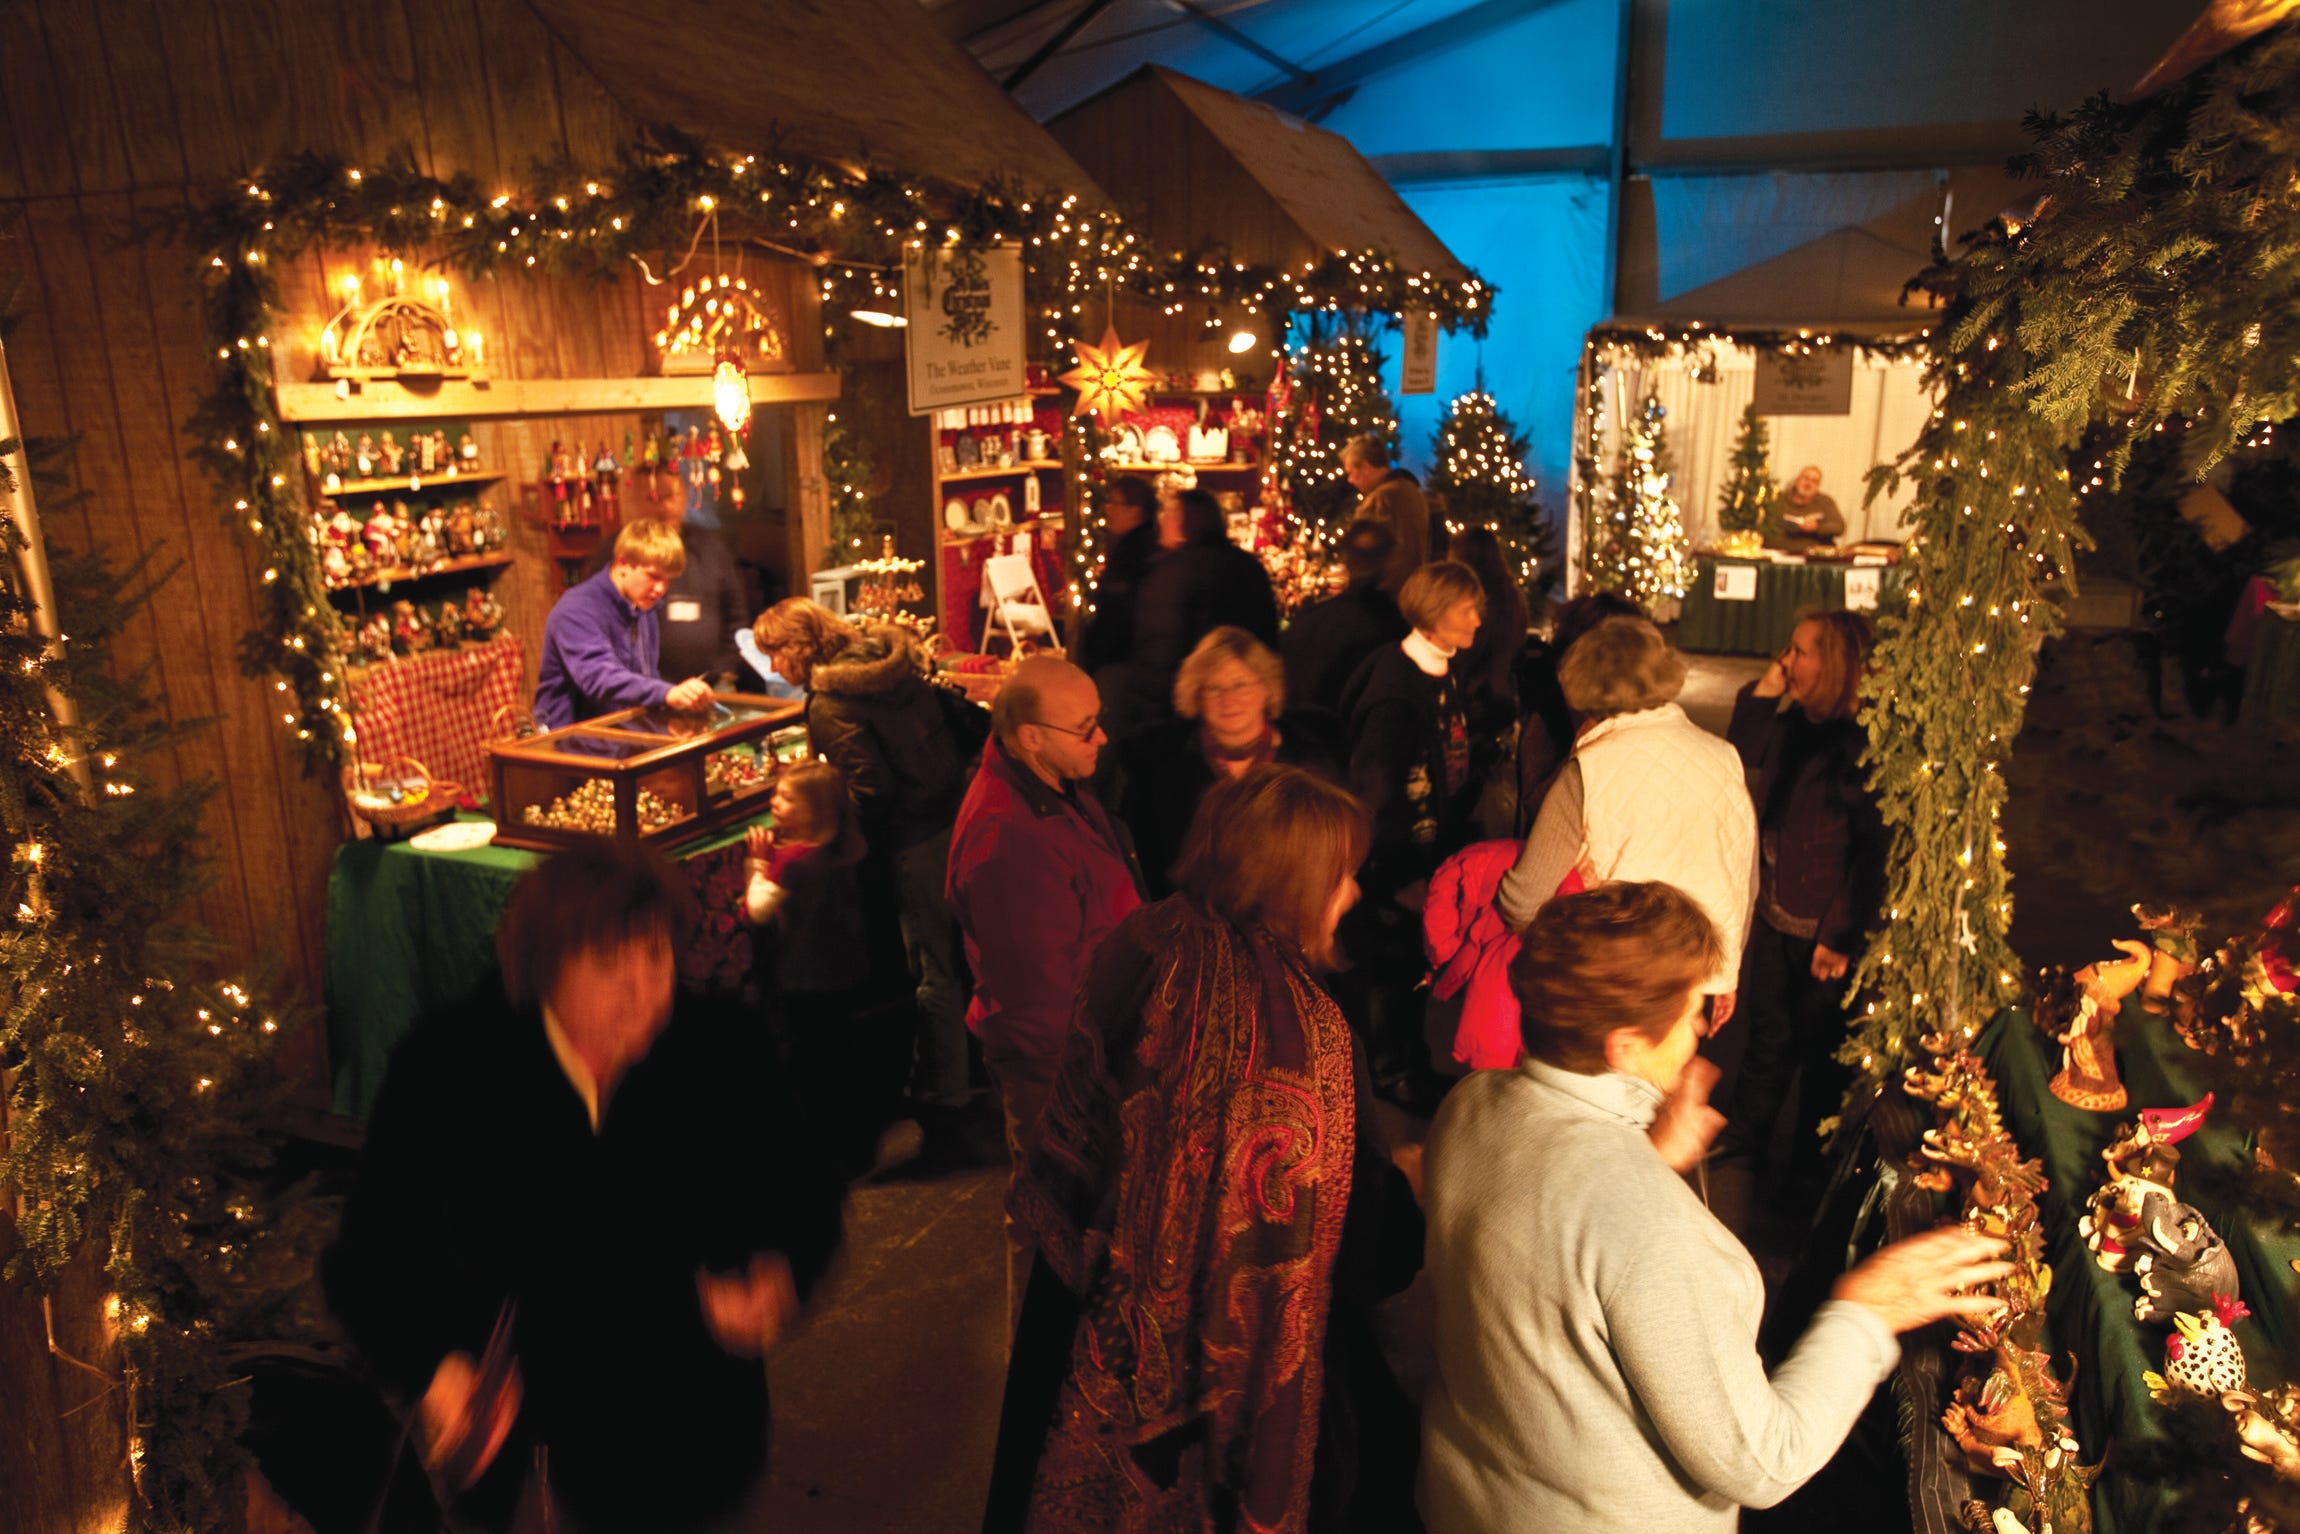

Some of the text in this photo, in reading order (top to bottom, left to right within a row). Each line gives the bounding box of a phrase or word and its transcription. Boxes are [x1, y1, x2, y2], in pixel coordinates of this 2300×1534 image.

[926, 357, 1011, 378] The Weather Vane
